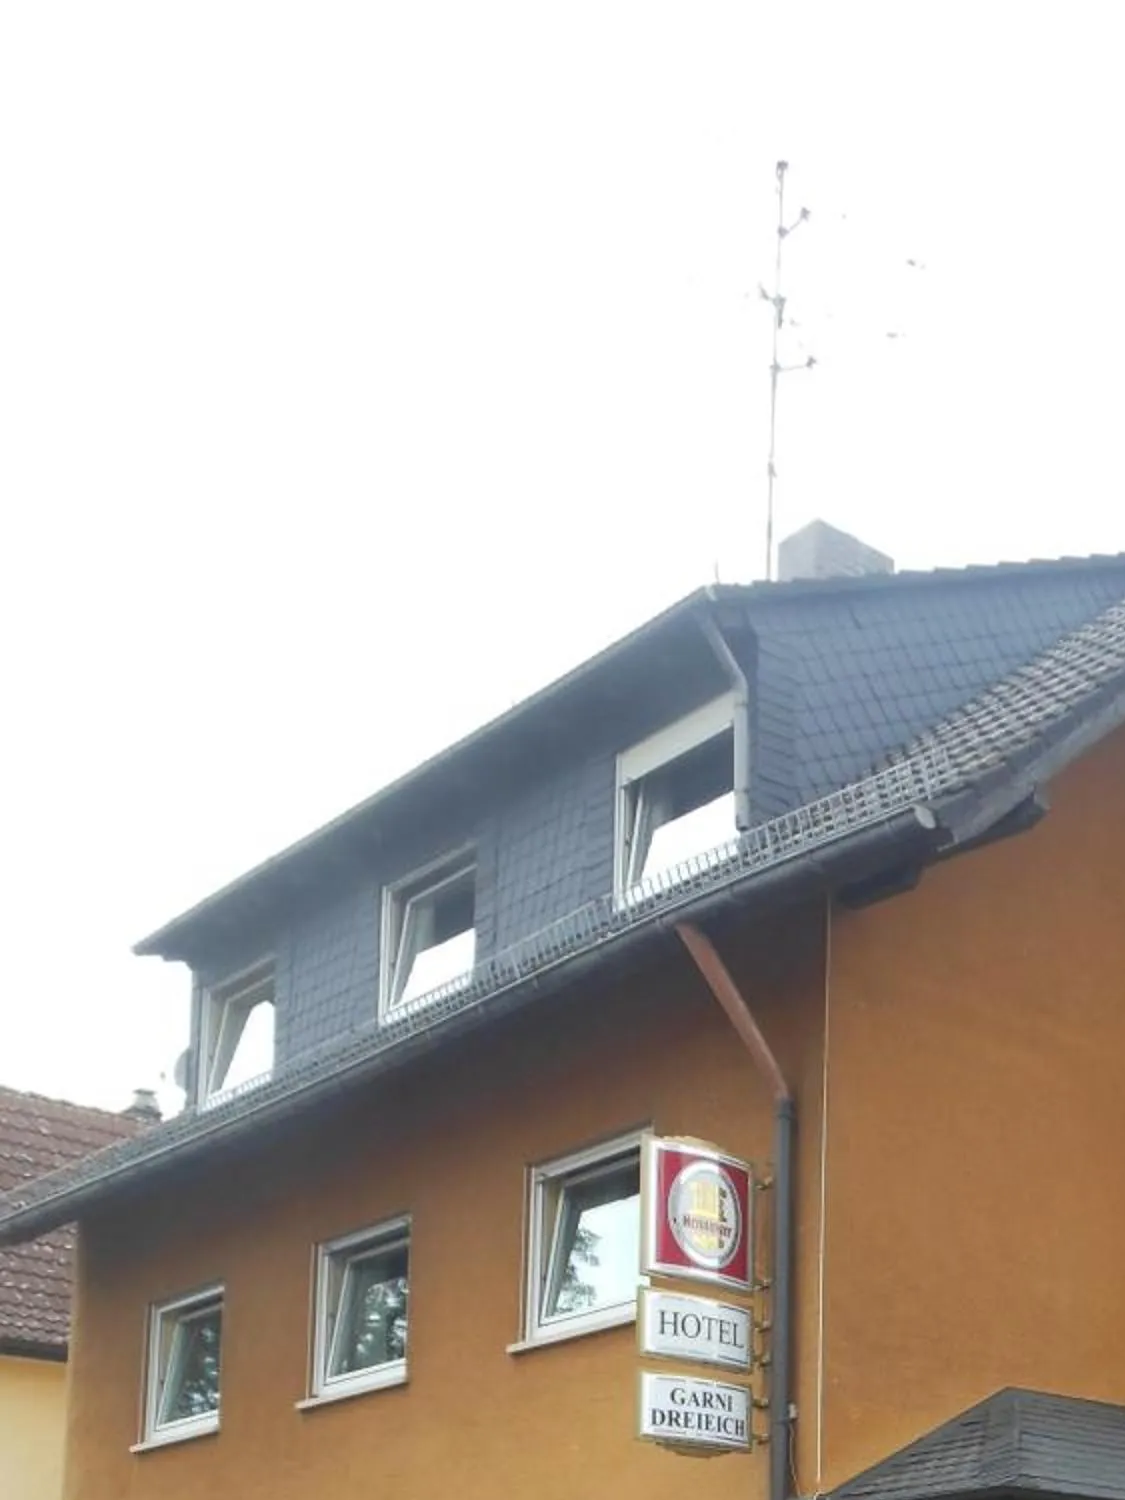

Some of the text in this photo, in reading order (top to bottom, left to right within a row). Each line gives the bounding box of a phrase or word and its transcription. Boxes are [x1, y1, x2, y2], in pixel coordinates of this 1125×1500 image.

[659, 1310, 745, 1348] HOTEL
[670, 1387, 733, 1413] GARNI
[650, 1408, 745, 1437] DREIEICH
